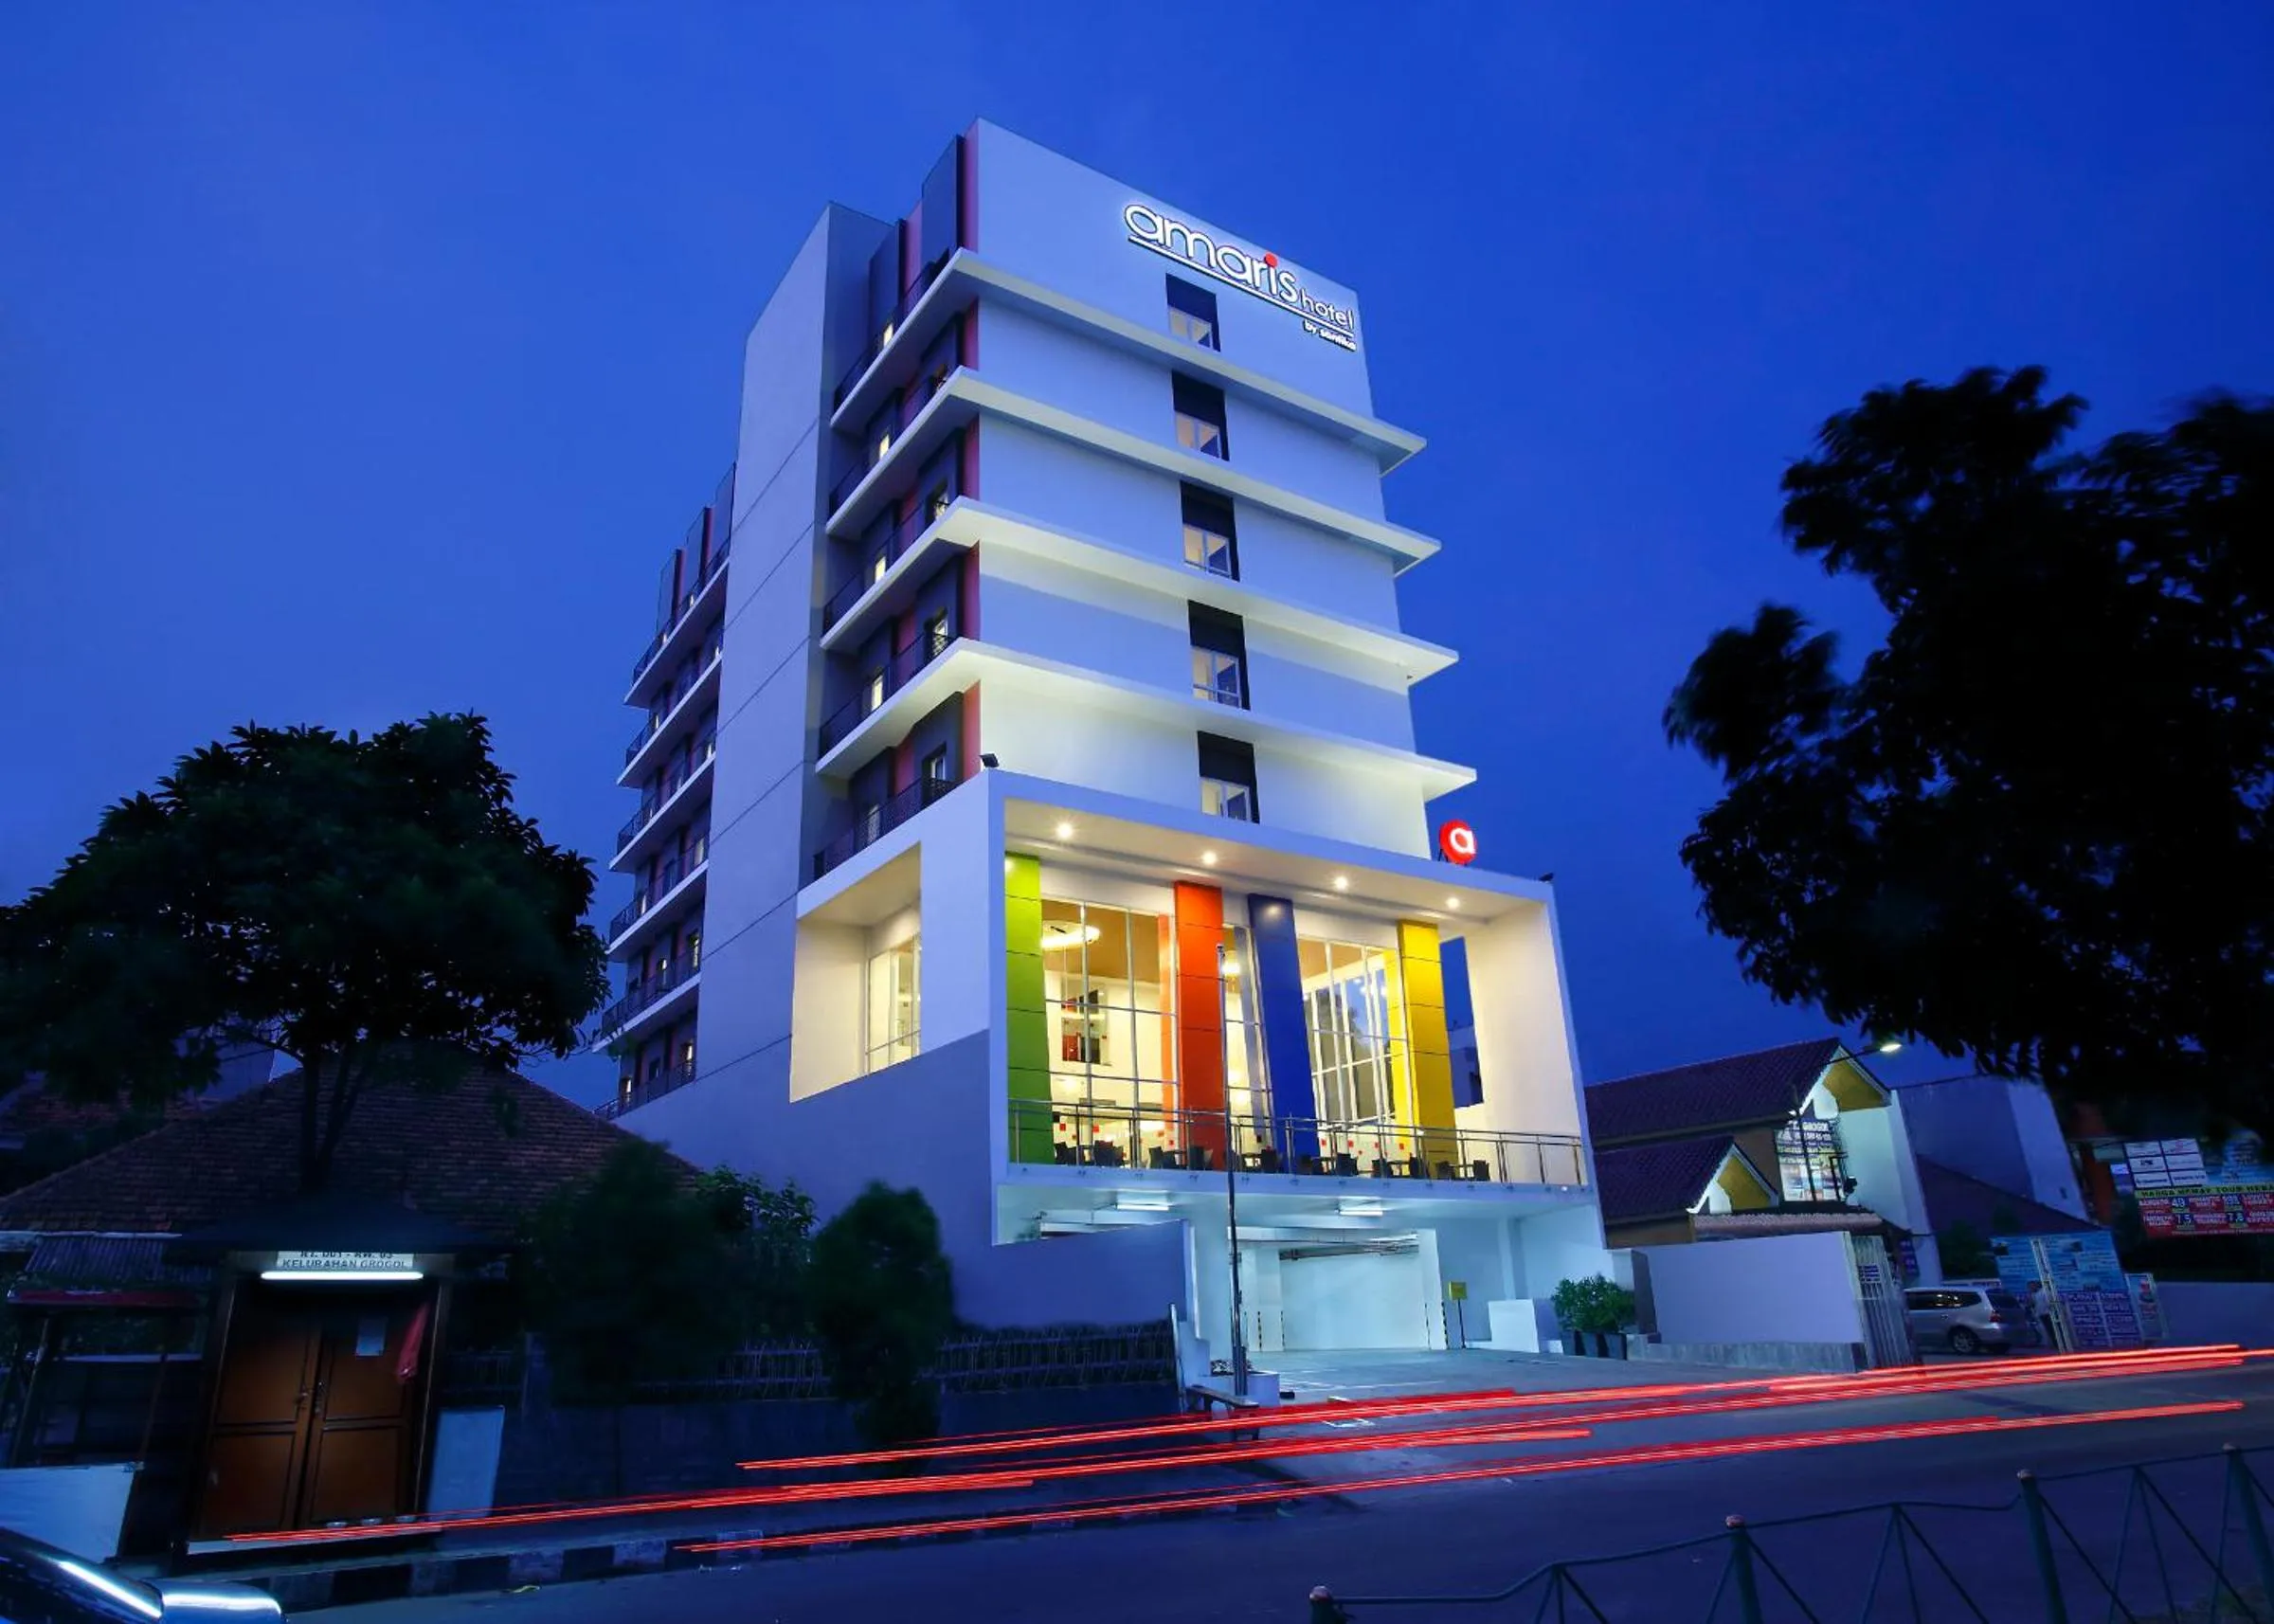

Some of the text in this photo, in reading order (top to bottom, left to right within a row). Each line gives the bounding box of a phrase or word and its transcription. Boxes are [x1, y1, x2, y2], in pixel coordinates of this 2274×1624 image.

[1124, 204, 1355, 330] amaris hotel
[1303, 318, 1318, 335] by
[282, 1259, 357, 1268] KELURAHAN
